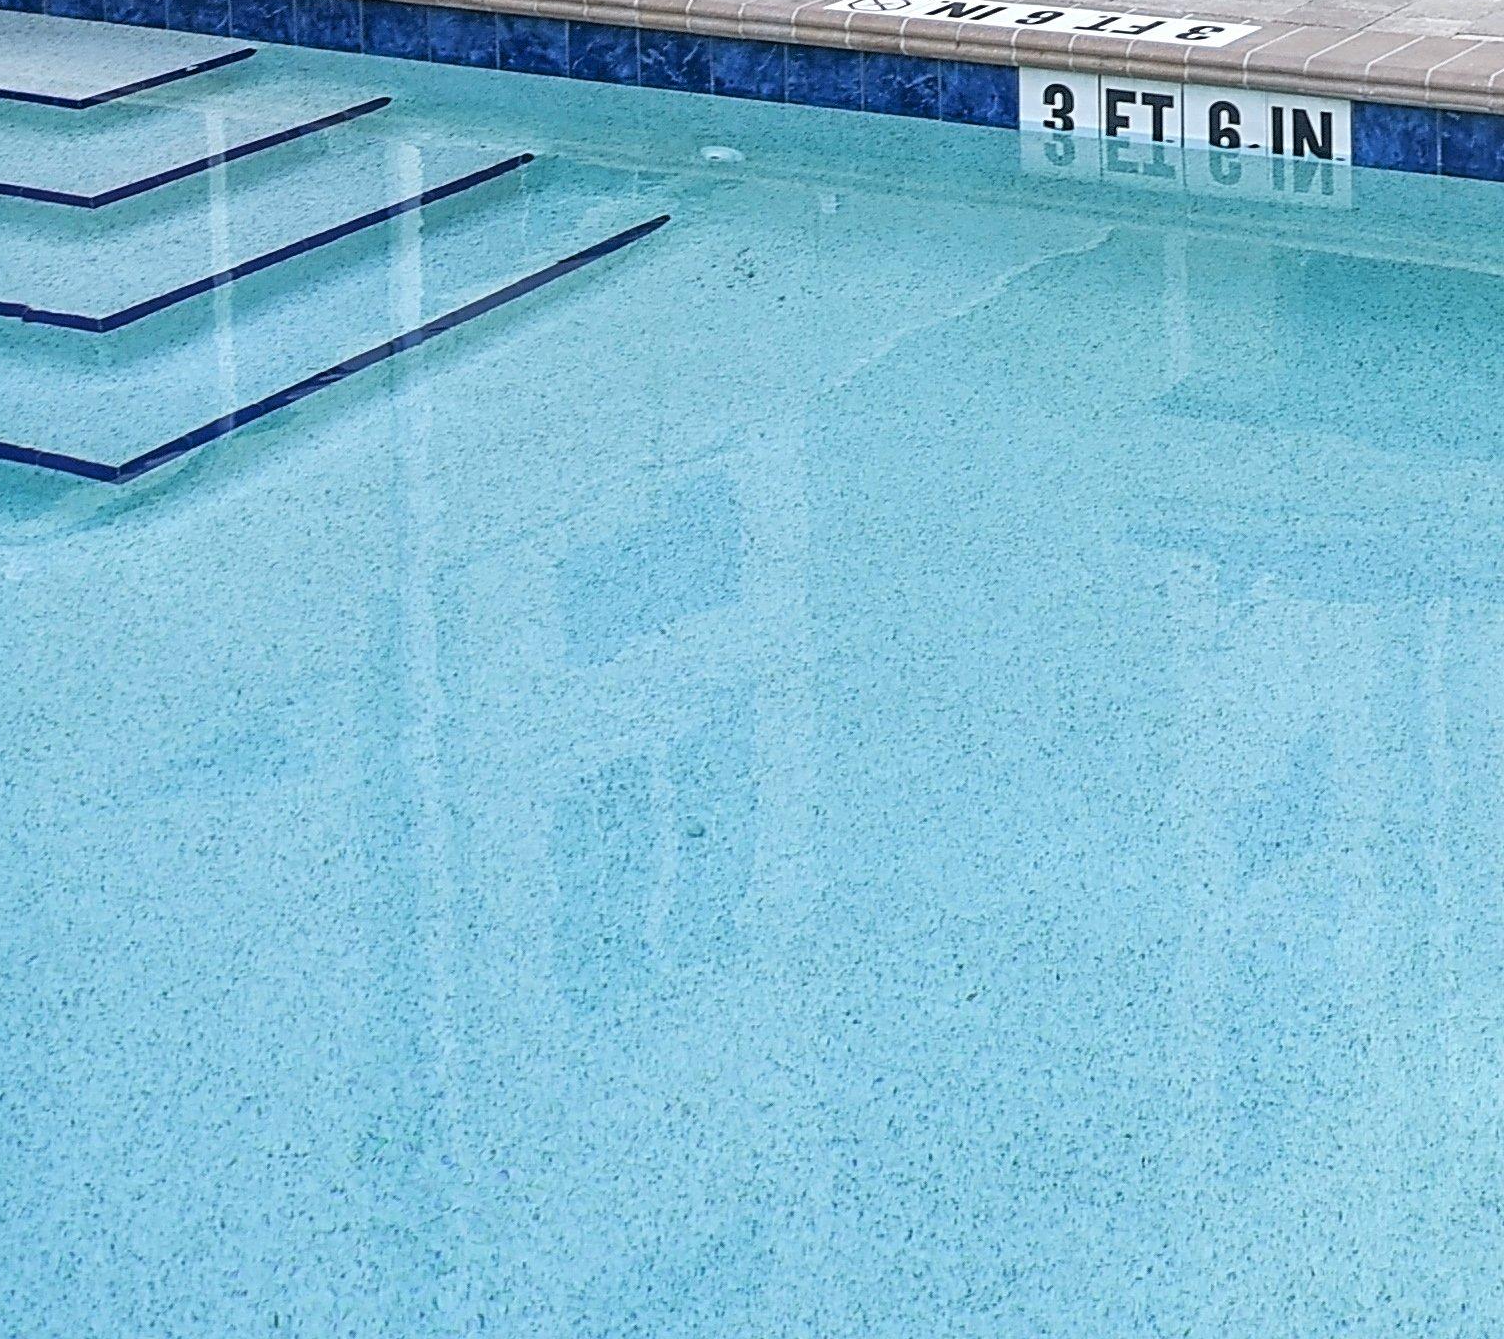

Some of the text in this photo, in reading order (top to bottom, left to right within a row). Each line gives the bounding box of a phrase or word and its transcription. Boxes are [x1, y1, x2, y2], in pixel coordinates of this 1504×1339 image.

[1015, 9, 1065, 26] 6
[1175, 25, 1226, 41] 3
[1042, 83, 1075, 131] 3
[1208, 100, 1241, 149] 6
